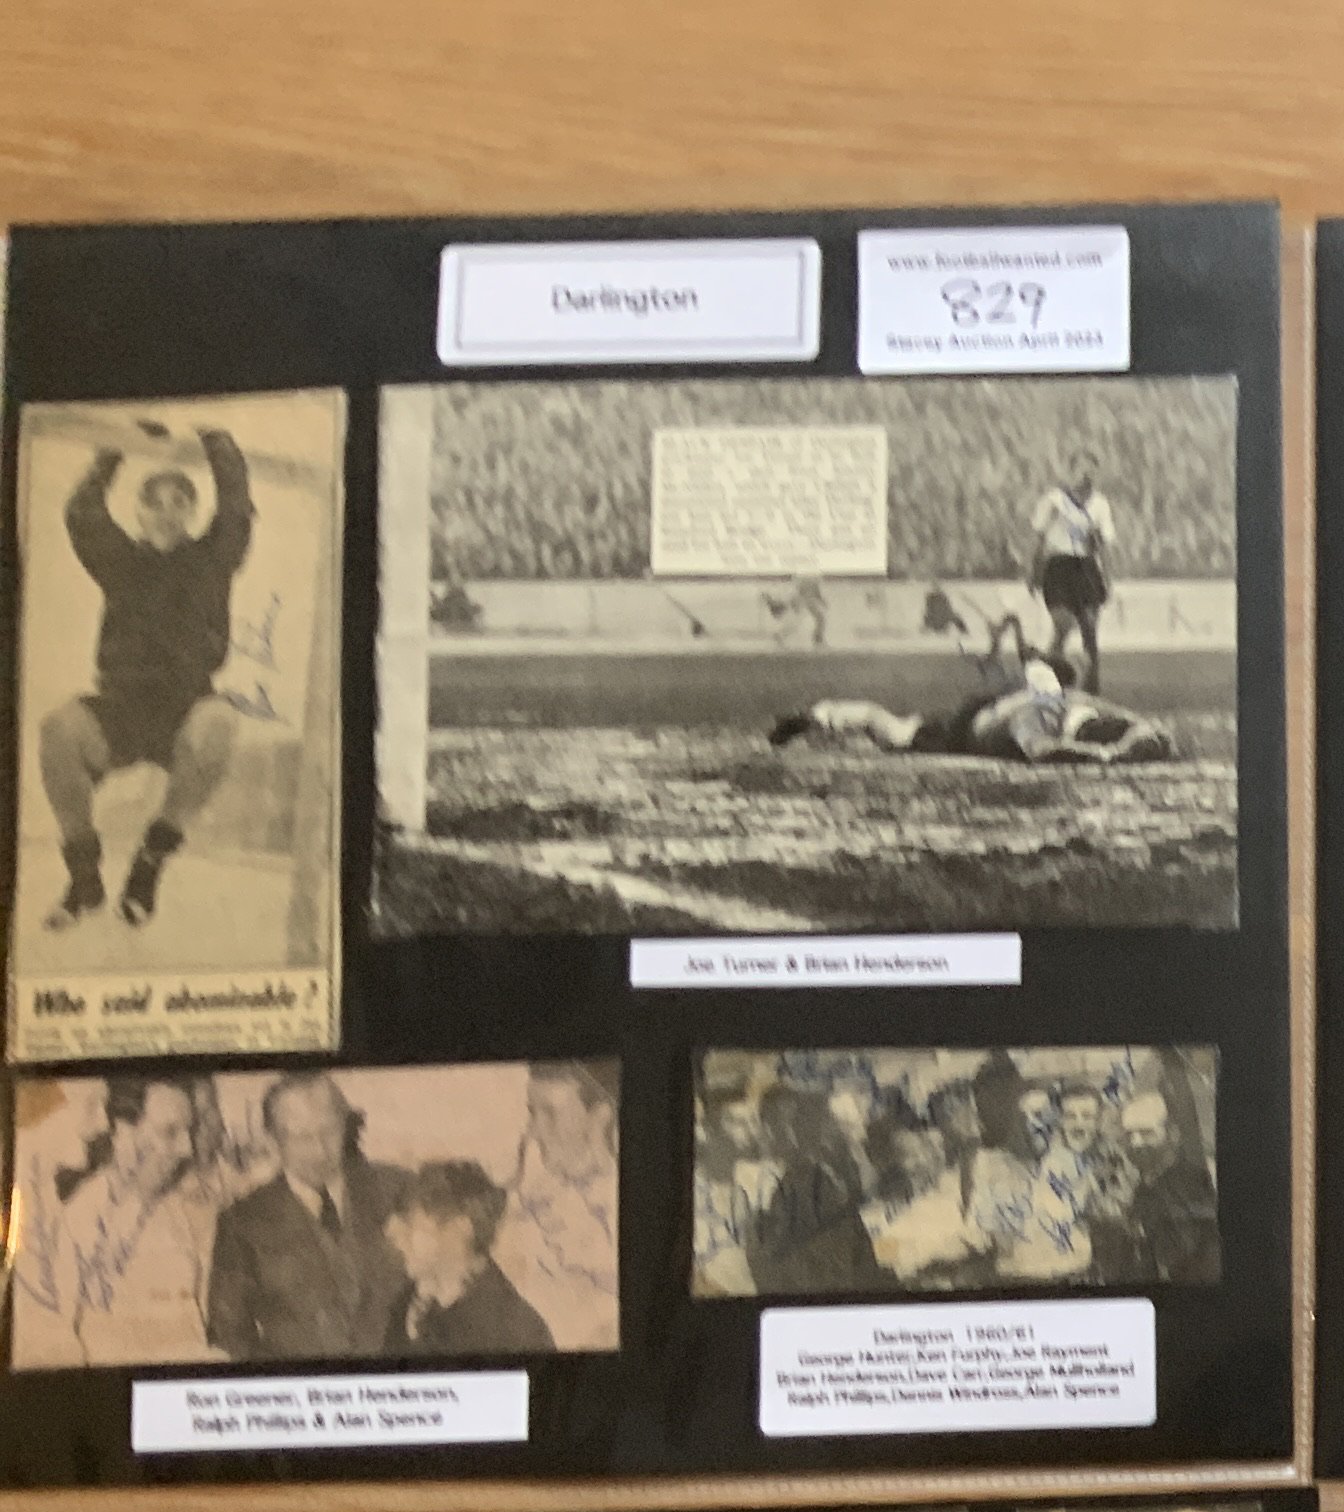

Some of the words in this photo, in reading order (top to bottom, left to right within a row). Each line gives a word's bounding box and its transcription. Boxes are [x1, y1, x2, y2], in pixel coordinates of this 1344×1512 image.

[552, 283, 699, 316] Darlington
[940, 277, 1047, 329] 829
[785, 954, 799, 972] &
[805, 953, 849, 973] Brian
[854, 952, 950, 973] Henderson
[101, 984, 152, 1016] said
[312, 1412, 325, 1429] &
[333, 1410, 373, 1429] Alan
